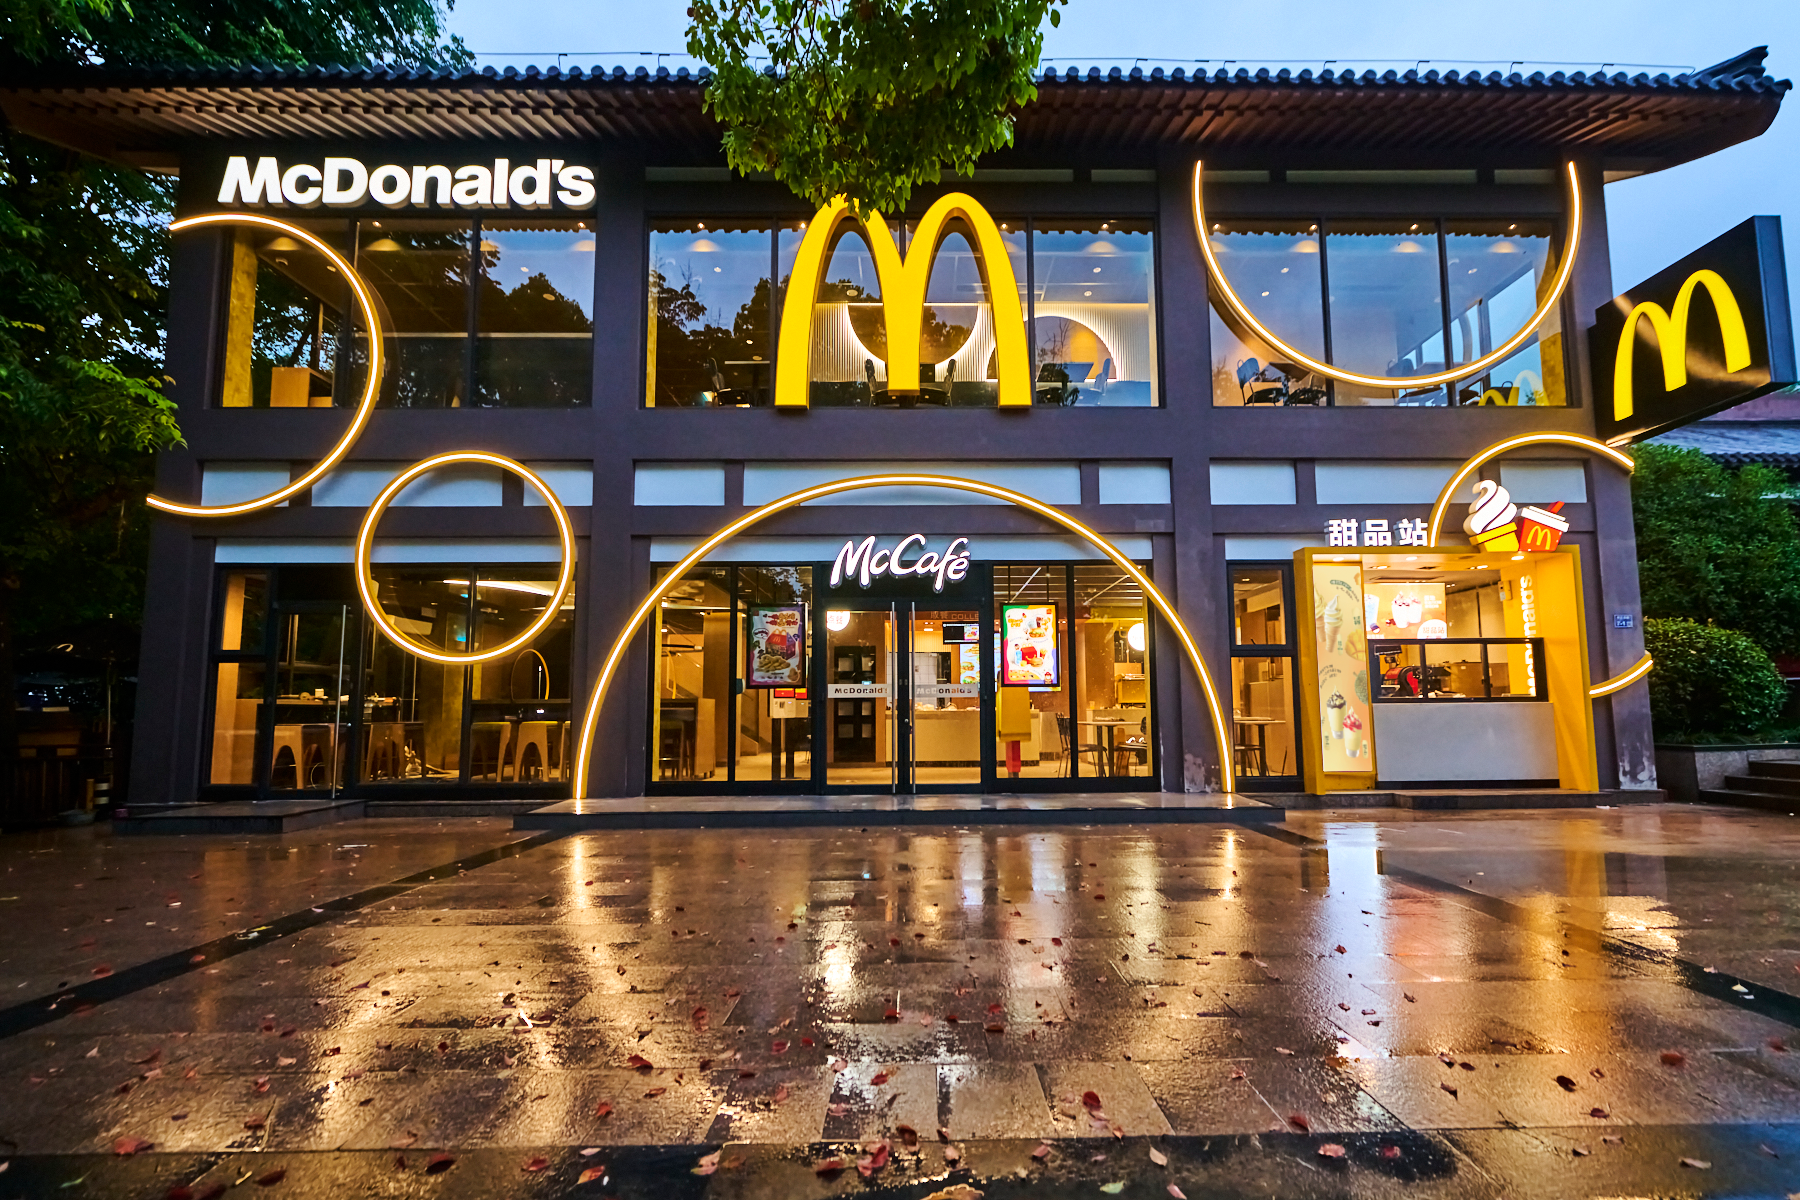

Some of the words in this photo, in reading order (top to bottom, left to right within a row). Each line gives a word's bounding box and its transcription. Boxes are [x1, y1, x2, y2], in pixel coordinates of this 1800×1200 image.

[217, 156, 596, 206] McDonald's
[1326, 517, 1429, 547] 甜品站
[830, 533, 970, 591] McCafé
